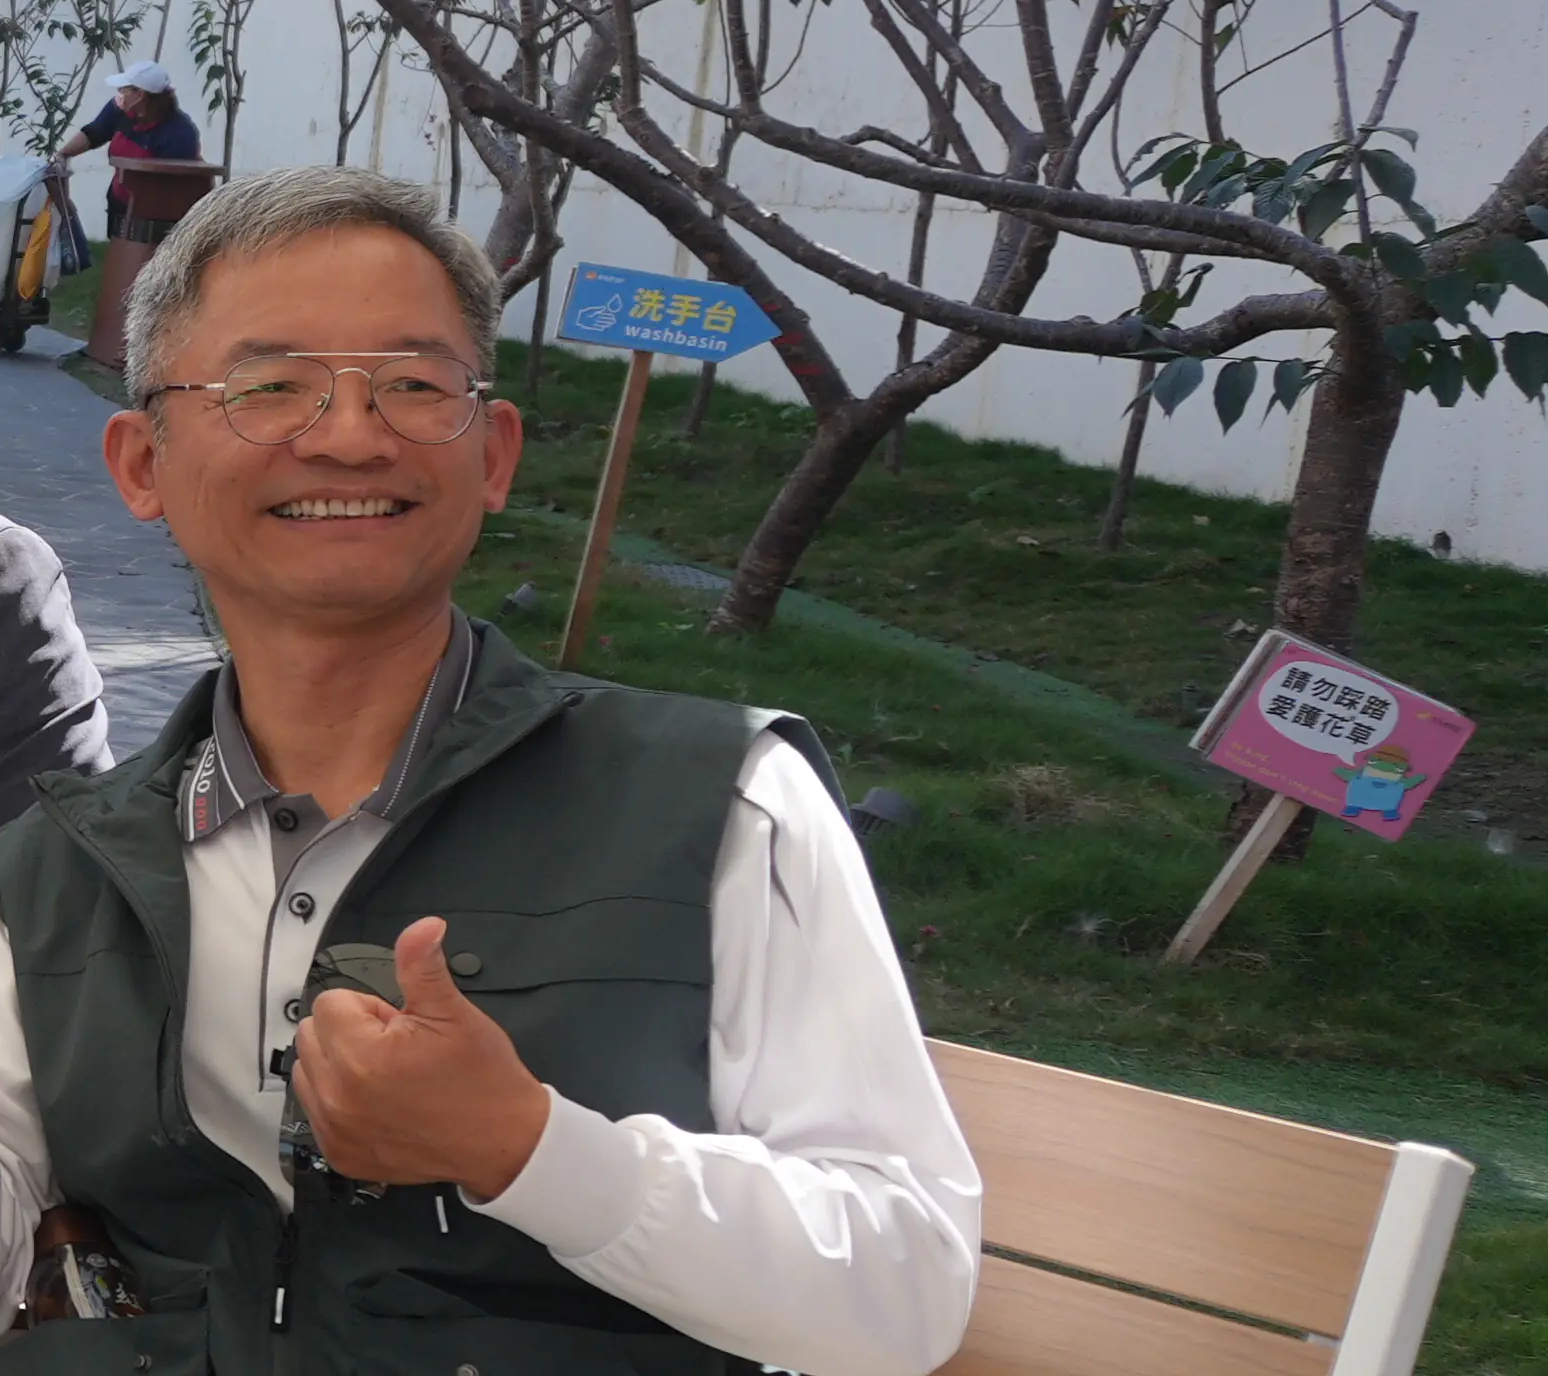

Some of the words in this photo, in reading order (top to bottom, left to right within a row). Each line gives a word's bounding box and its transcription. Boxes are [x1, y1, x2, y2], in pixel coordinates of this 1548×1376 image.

[629, 287, 737, 334] 洗手台
[625, 324, 728, 353] washbasin
[1280, 666, 1393, 722] 請勿踩踏
[1266, 693, 1378, 746] 愛護花草
